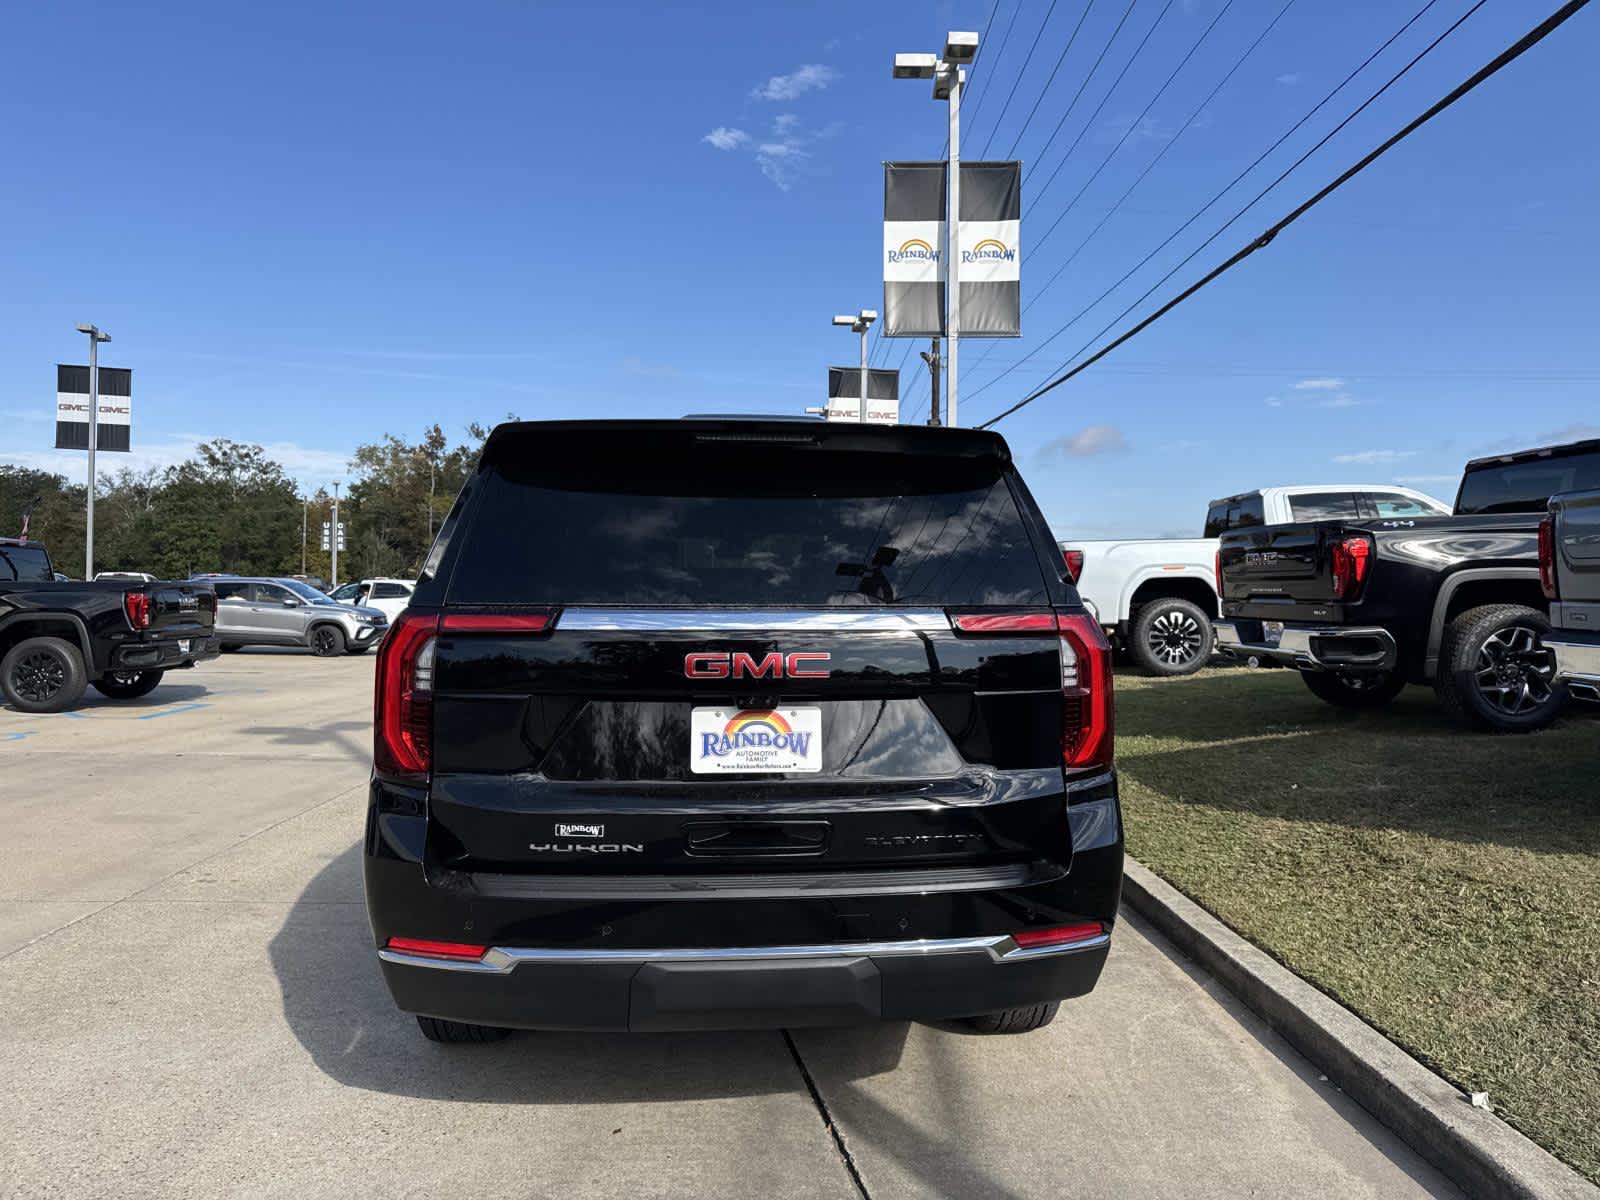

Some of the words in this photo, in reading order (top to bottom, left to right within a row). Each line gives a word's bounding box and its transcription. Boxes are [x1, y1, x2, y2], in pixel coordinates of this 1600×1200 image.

[58, 403, 89, 412] GMC
[99, 406, 130, 414] GMC
[829, 410, 859, 418] GMC
[867, 411, 897, 420] GMC
[684, 652, 832, 679] GMC
[700, 731, 812, 760] RAINBOW
[529, 843, 644, 853] YUKON
